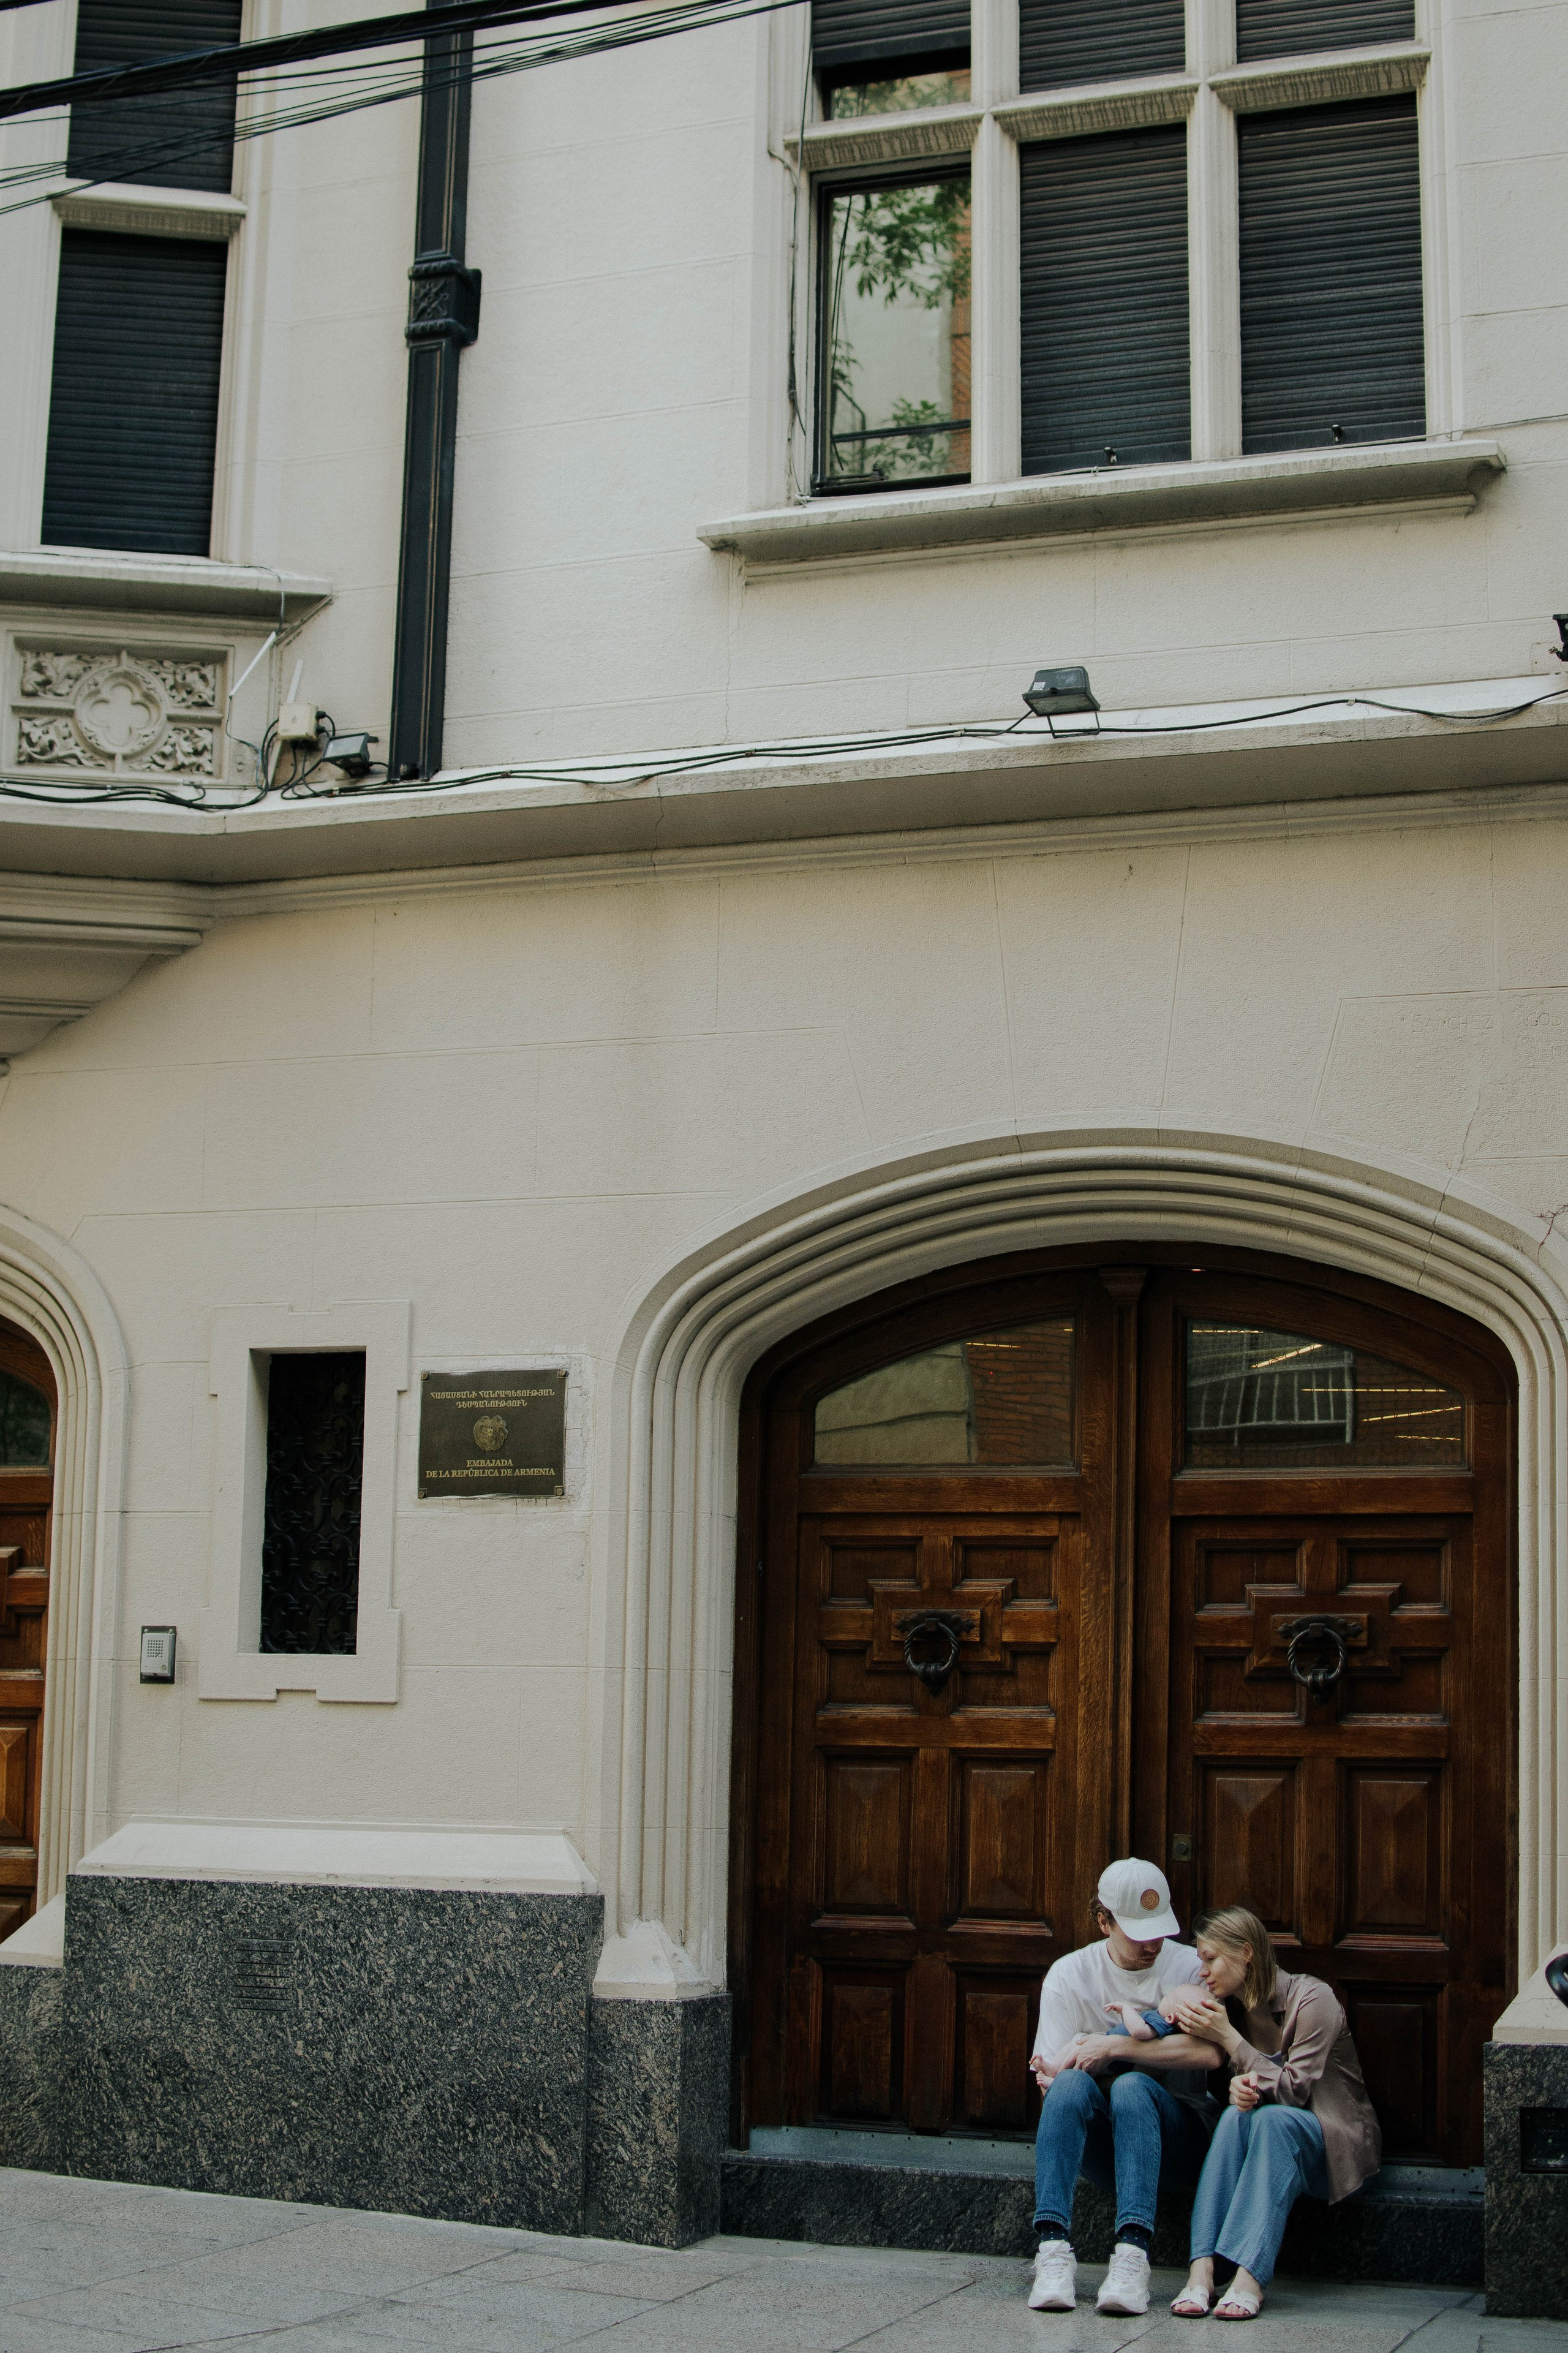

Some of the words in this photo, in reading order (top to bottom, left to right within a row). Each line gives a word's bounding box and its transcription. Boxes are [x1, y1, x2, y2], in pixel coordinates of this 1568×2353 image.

[478, 1388, 555, 1398] ՀԱՆՐԱՊԵՏՈՒԹՅԱՆ
[456, 1399, 527, 1408] ԴԵՍՊԱՆՈՒԹՅՈՒՆ
[451, 1468, 499, 1478] REPÚBLICA
[514, 1468, 556, 1476] ARMENIA
